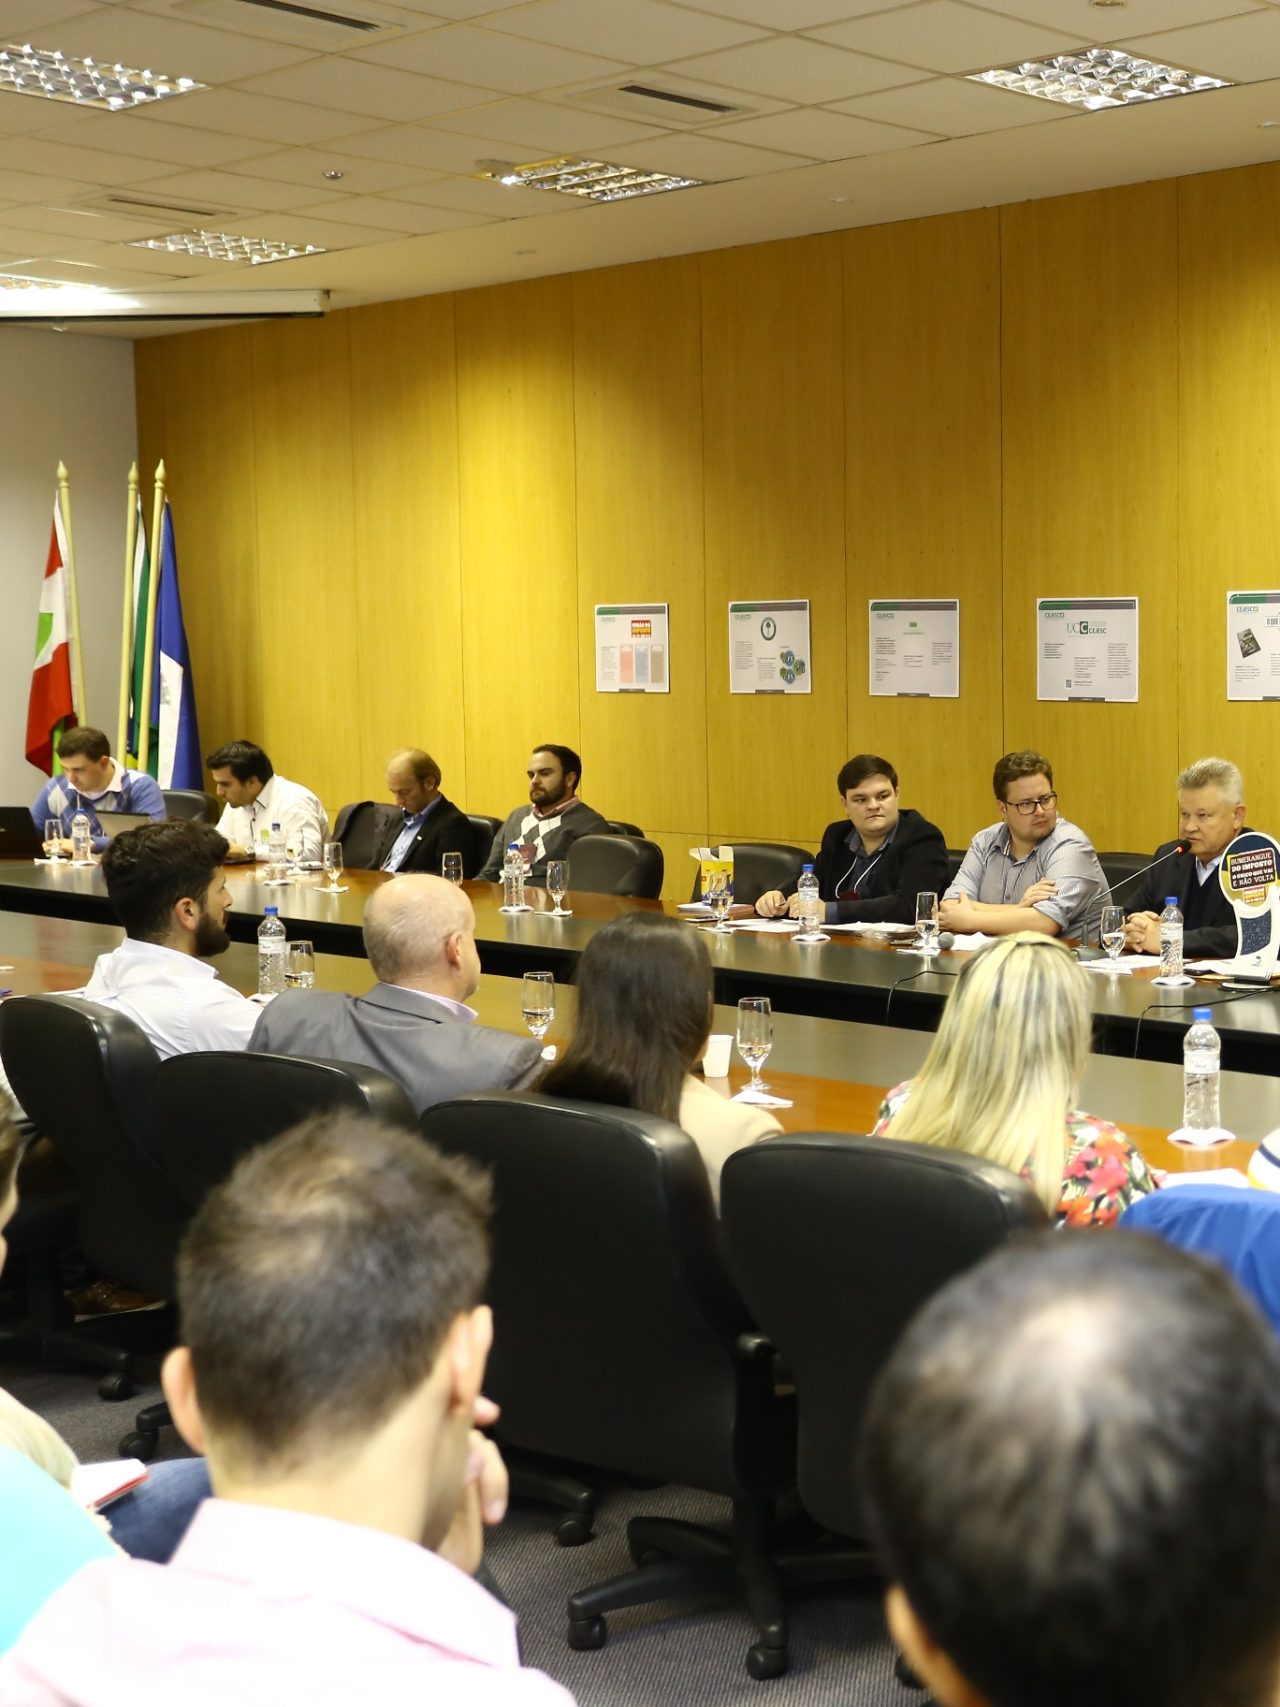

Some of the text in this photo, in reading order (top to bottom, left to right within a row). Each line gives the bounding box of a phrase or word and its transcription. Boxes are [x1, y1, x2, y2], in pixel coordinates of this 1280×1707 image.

[1231, 852, 1271, 865] BUMERANGUE
[1242, 859, 1272, 870] IMPOSTO
[1254, 874, 1274, 882] VOLTA
